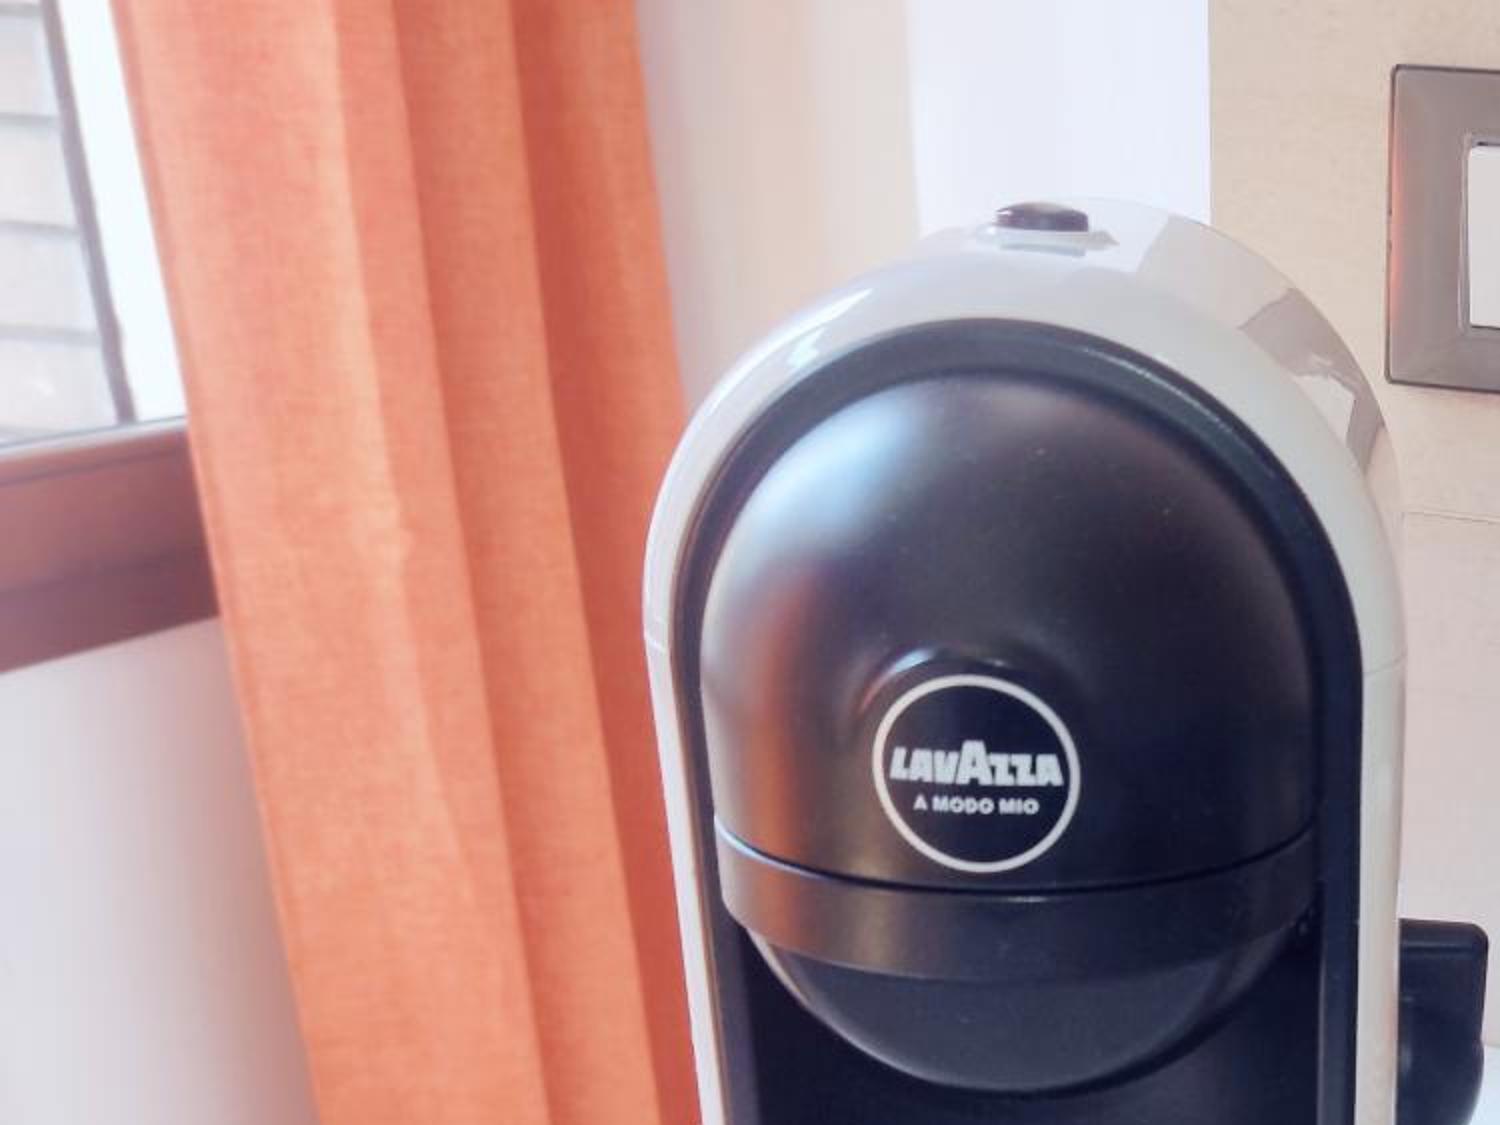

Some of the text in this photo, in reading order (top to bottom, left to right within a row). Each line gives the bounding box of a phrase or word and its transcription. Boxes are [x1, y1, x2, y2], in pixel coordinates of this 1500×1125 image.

[889, 740, 1064, 786] LAVAZZA
[913, 794, 1040, 815] A MODO MIO
